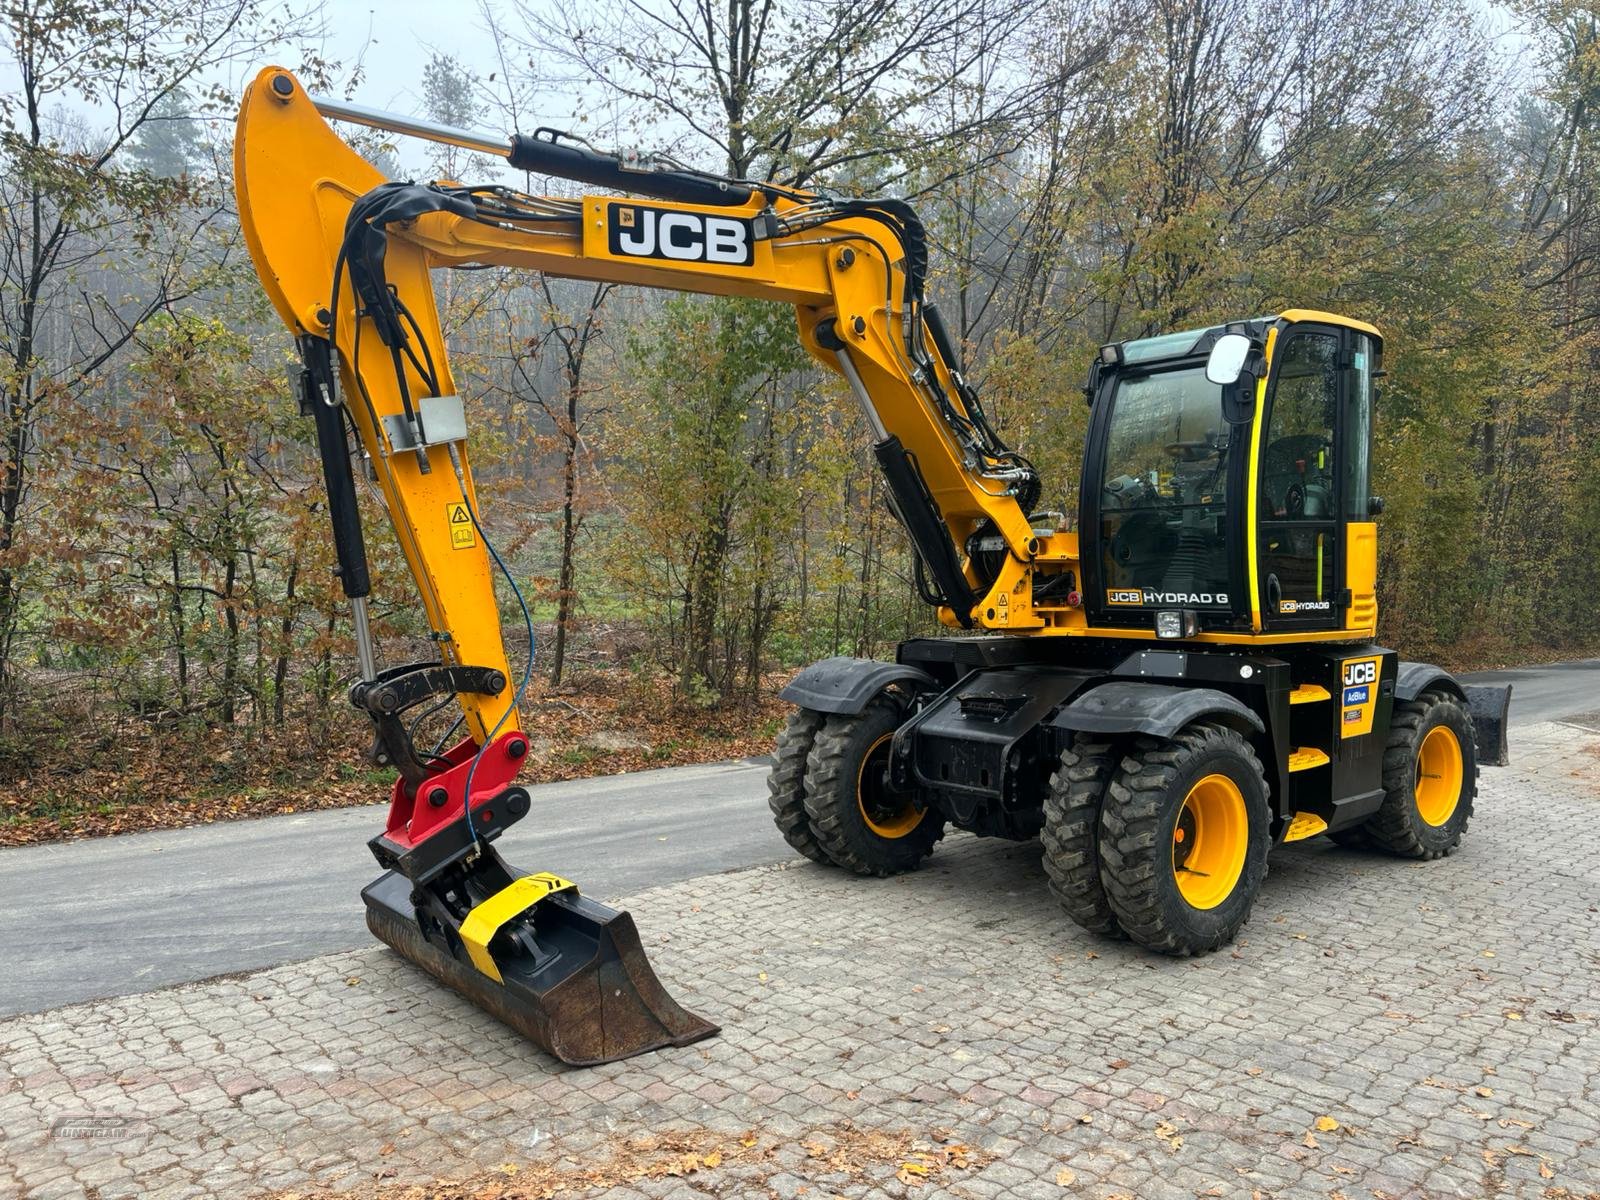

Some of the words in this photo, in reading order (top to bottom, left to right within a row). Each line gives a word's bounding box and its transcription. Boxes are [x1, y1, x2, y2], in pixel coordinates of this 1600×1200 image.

[619, 210, 748, 264] JCB
[1109, 591, 1140, 603] JCB
[1344, 662, 1376, 686] JCB
[1347, 691, 1366, 702] AdBlue
